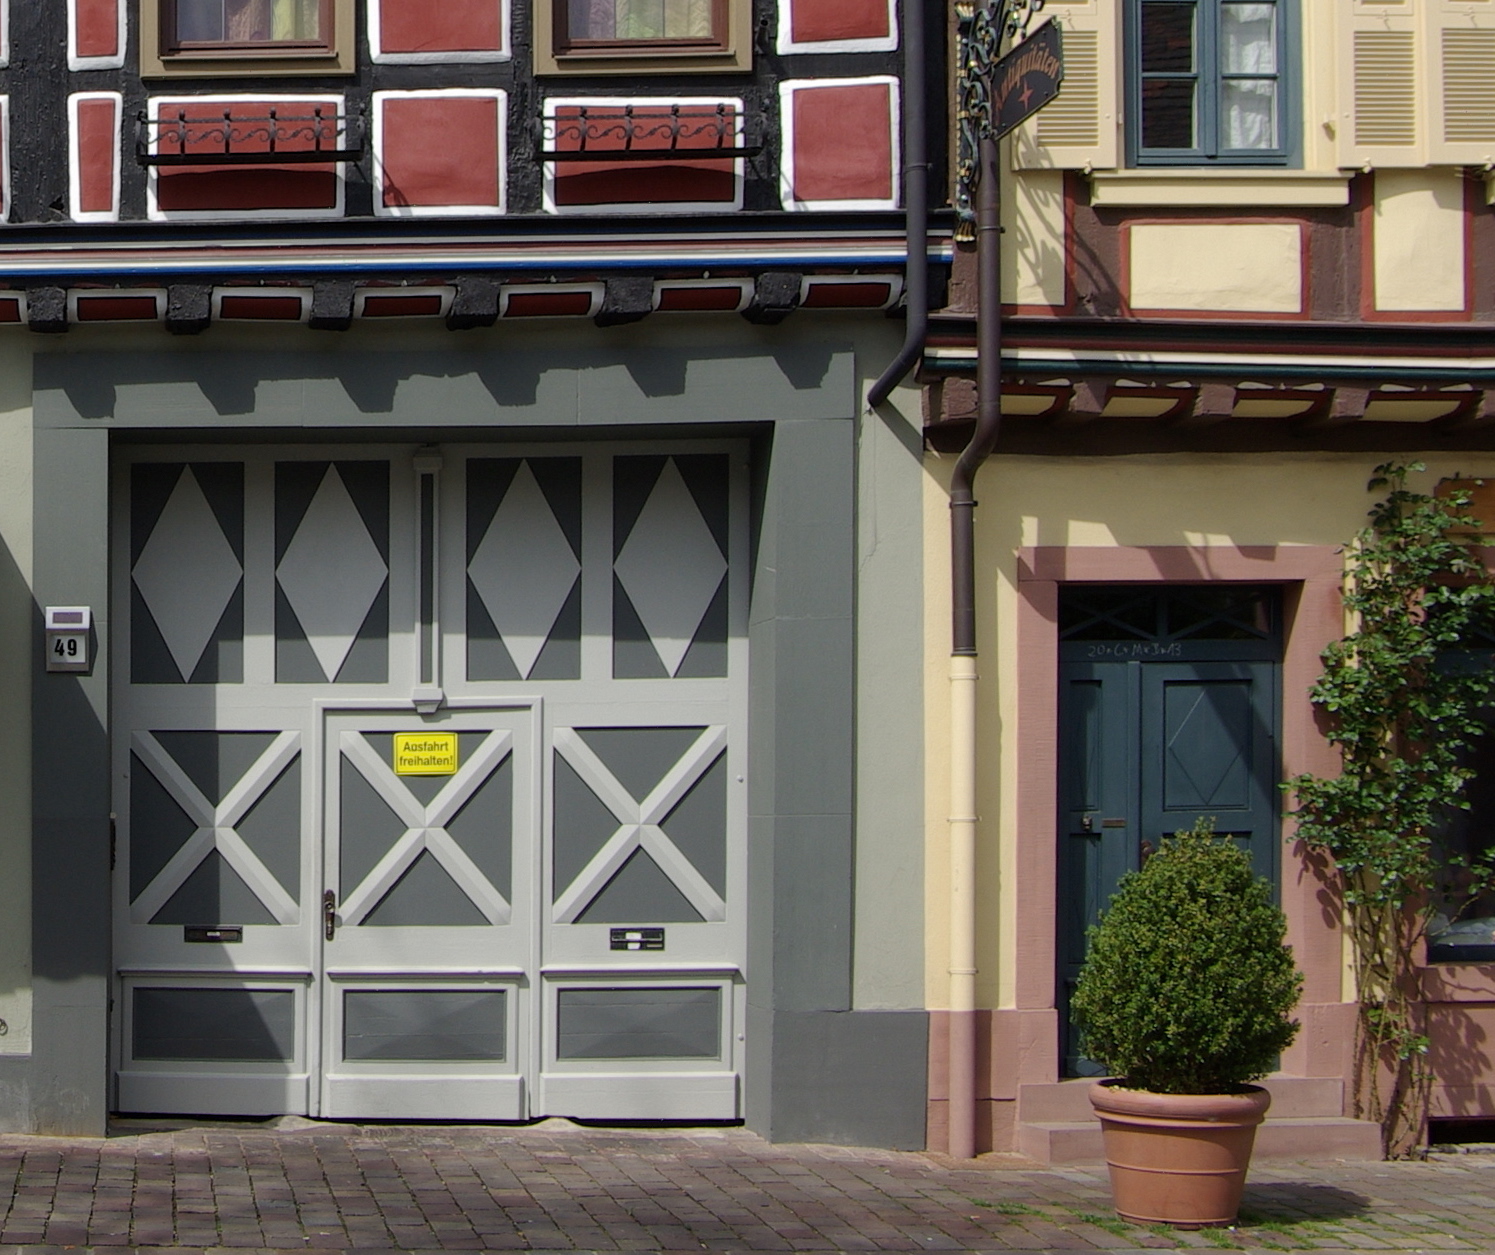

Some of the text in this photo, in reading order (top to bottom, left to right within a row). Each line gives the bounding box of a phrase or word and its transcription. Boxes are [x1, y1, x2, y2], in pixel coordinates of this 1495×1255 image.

[54, 639, 77, 656] 49
[403, 741, 449, 752] Ausfahrt
[400, 755, 453, 766] freihalten!
